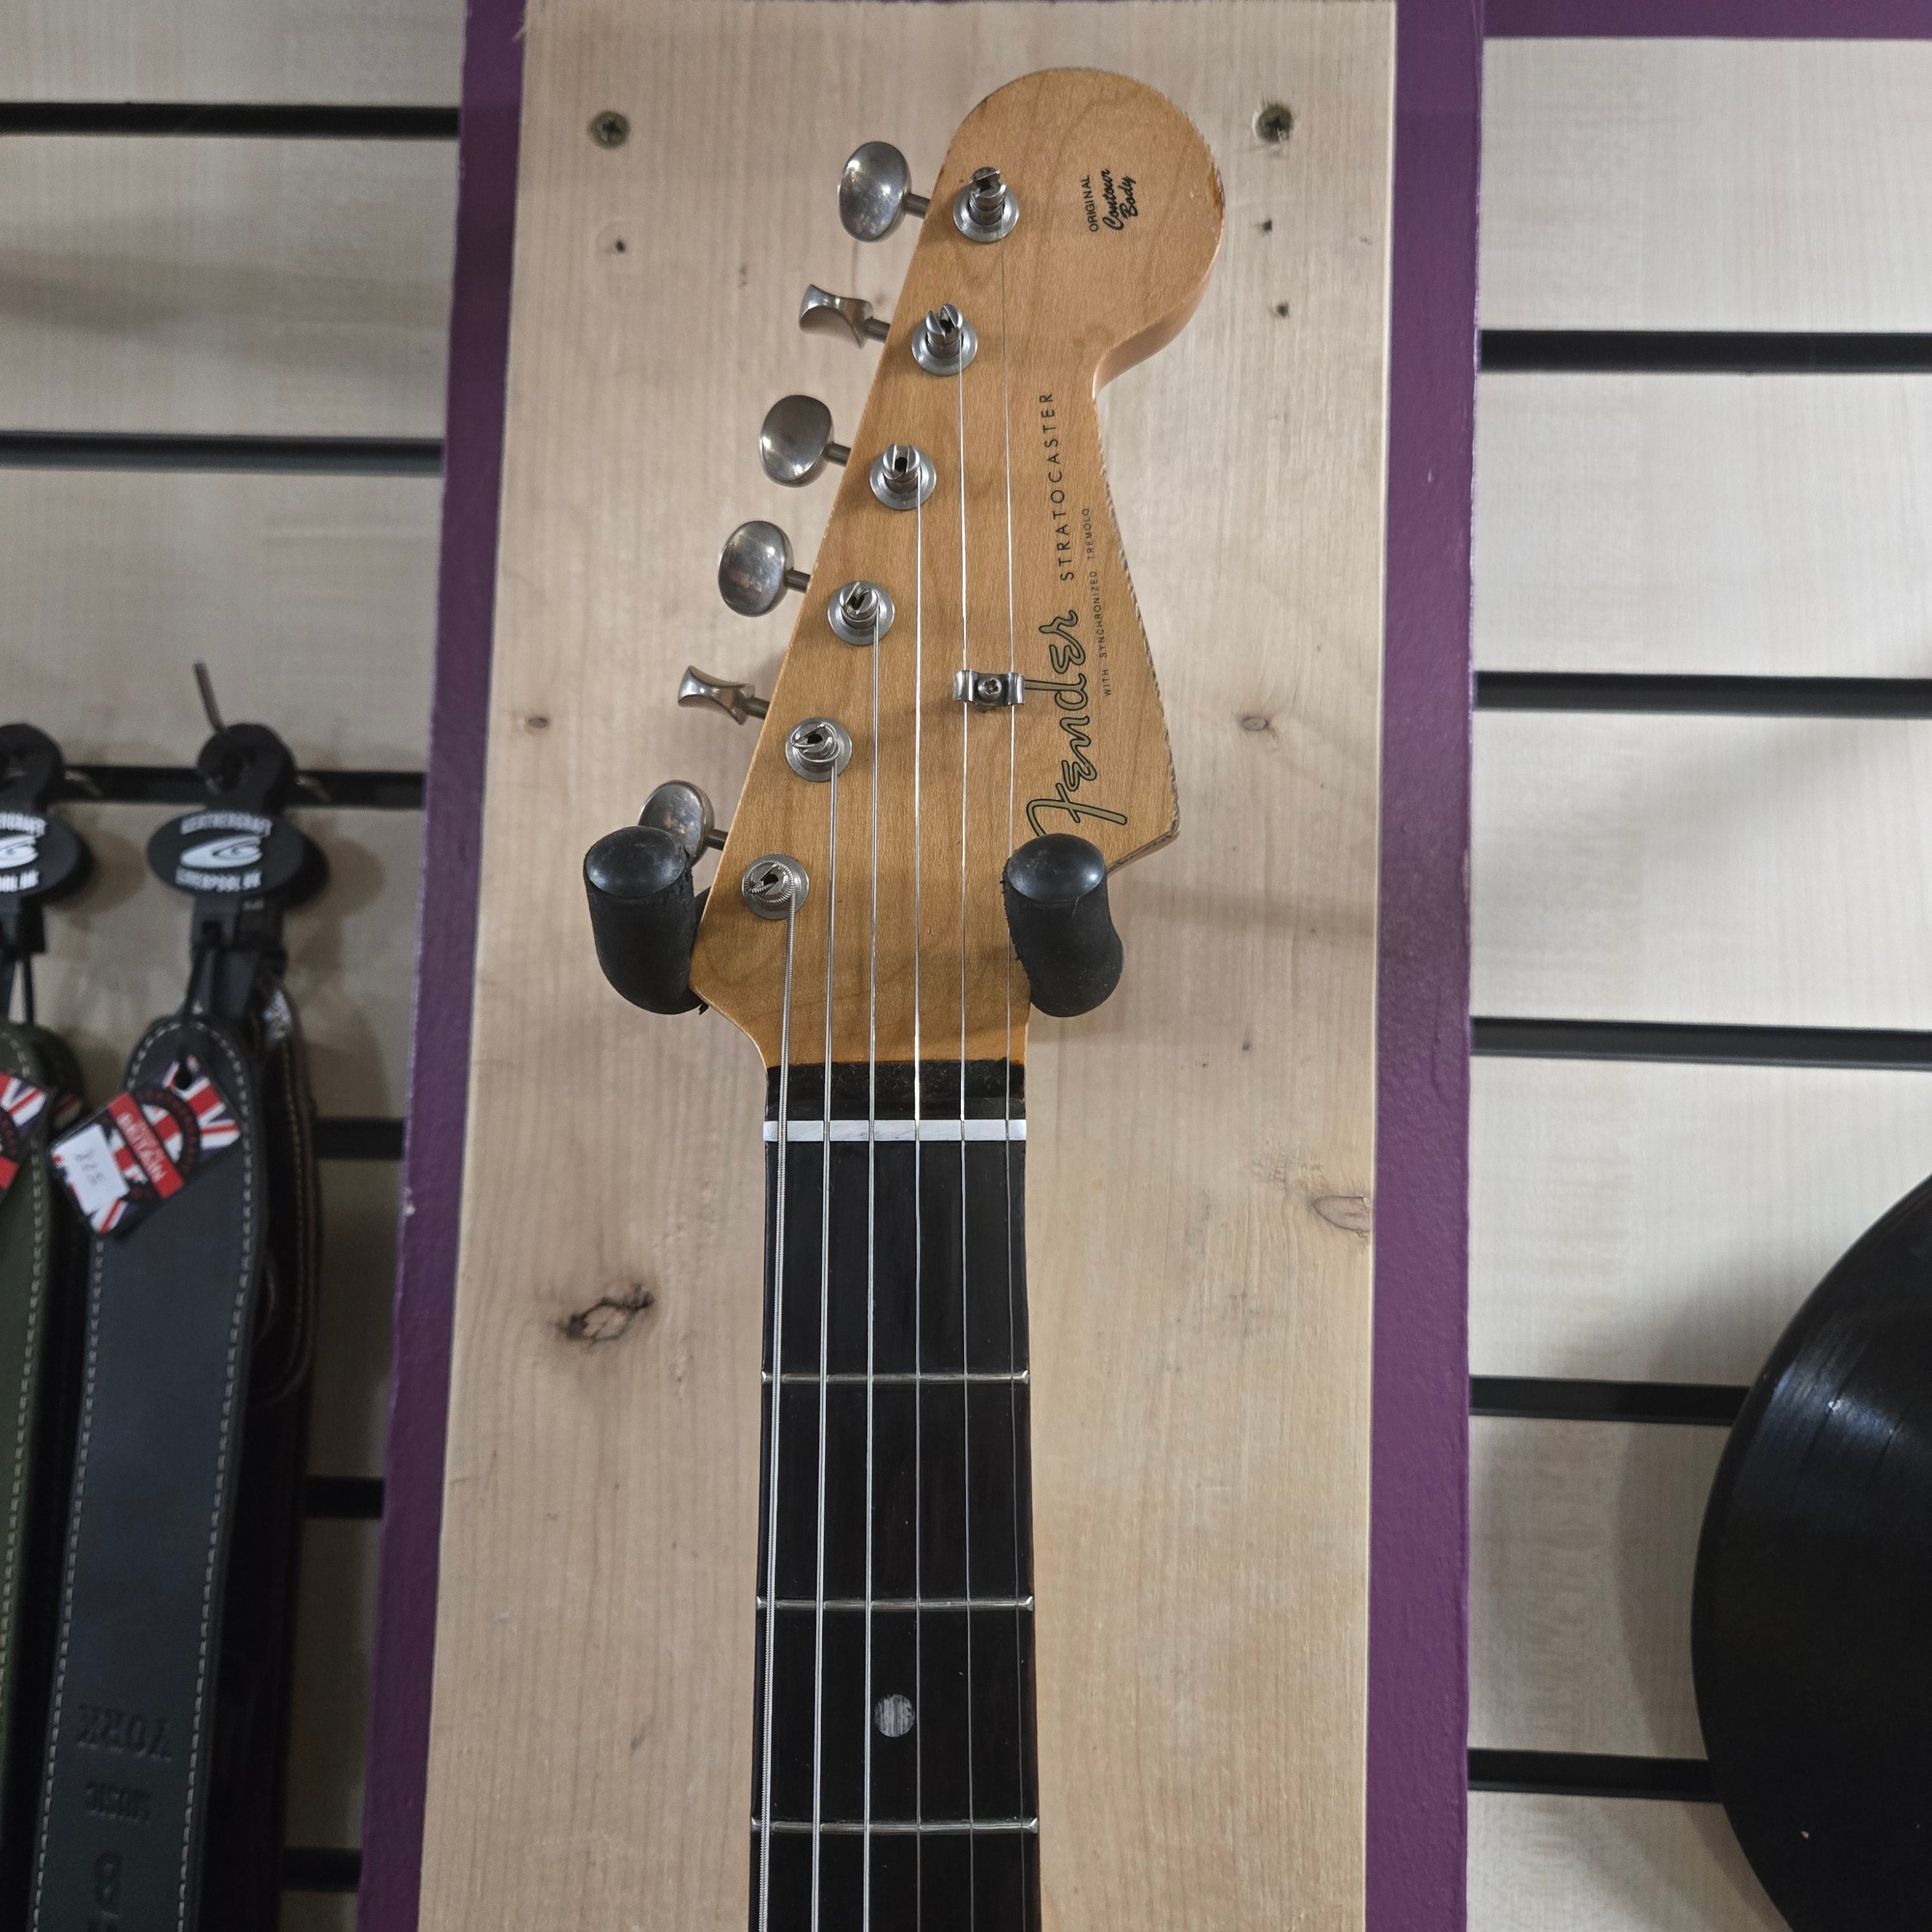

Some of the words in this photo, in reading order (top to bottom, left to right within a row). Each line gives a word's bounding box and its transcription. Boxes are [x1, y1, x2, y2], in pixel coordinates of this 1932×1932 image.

[1081, 175, 1099, 232] ORIGINAL
[1101, 169, 1124, 231] Contour
[1118, 176, 1137, 219] Body
[1039, 393, 1074, 581] STRATOCASTER
[1082, 508, 1095, 560] TREMOLO
[1089, 571, 1107, 658] SYNCHRONIZED
[1102, 669, 1111, 697] WITH
[1025, 610, 1128, 836] Fender
